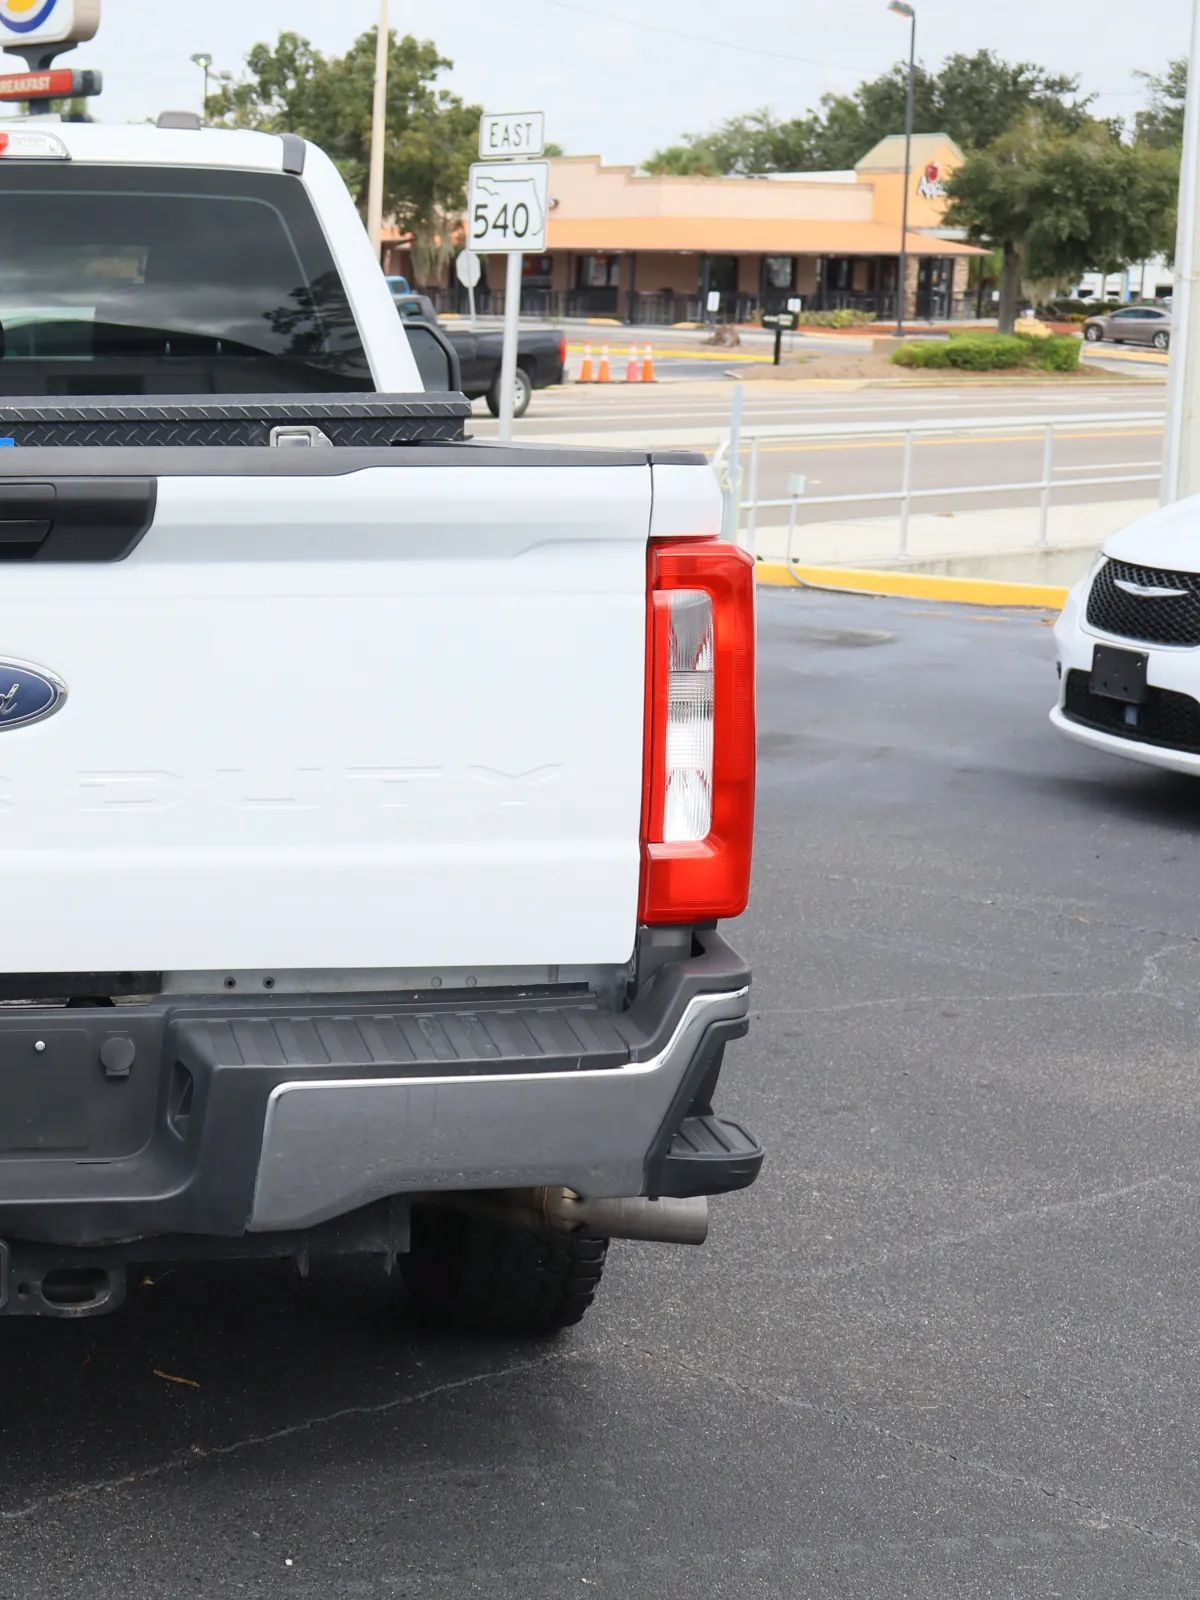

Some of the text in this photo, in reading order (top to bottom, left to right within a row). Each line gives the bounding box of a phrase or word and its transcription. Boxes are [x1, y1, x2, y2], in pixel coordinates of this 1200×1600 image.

[490, 122, 532, 148] EAST
[473, 202, 530, 239] 540
[77, 763, 564, 812] DUTY
